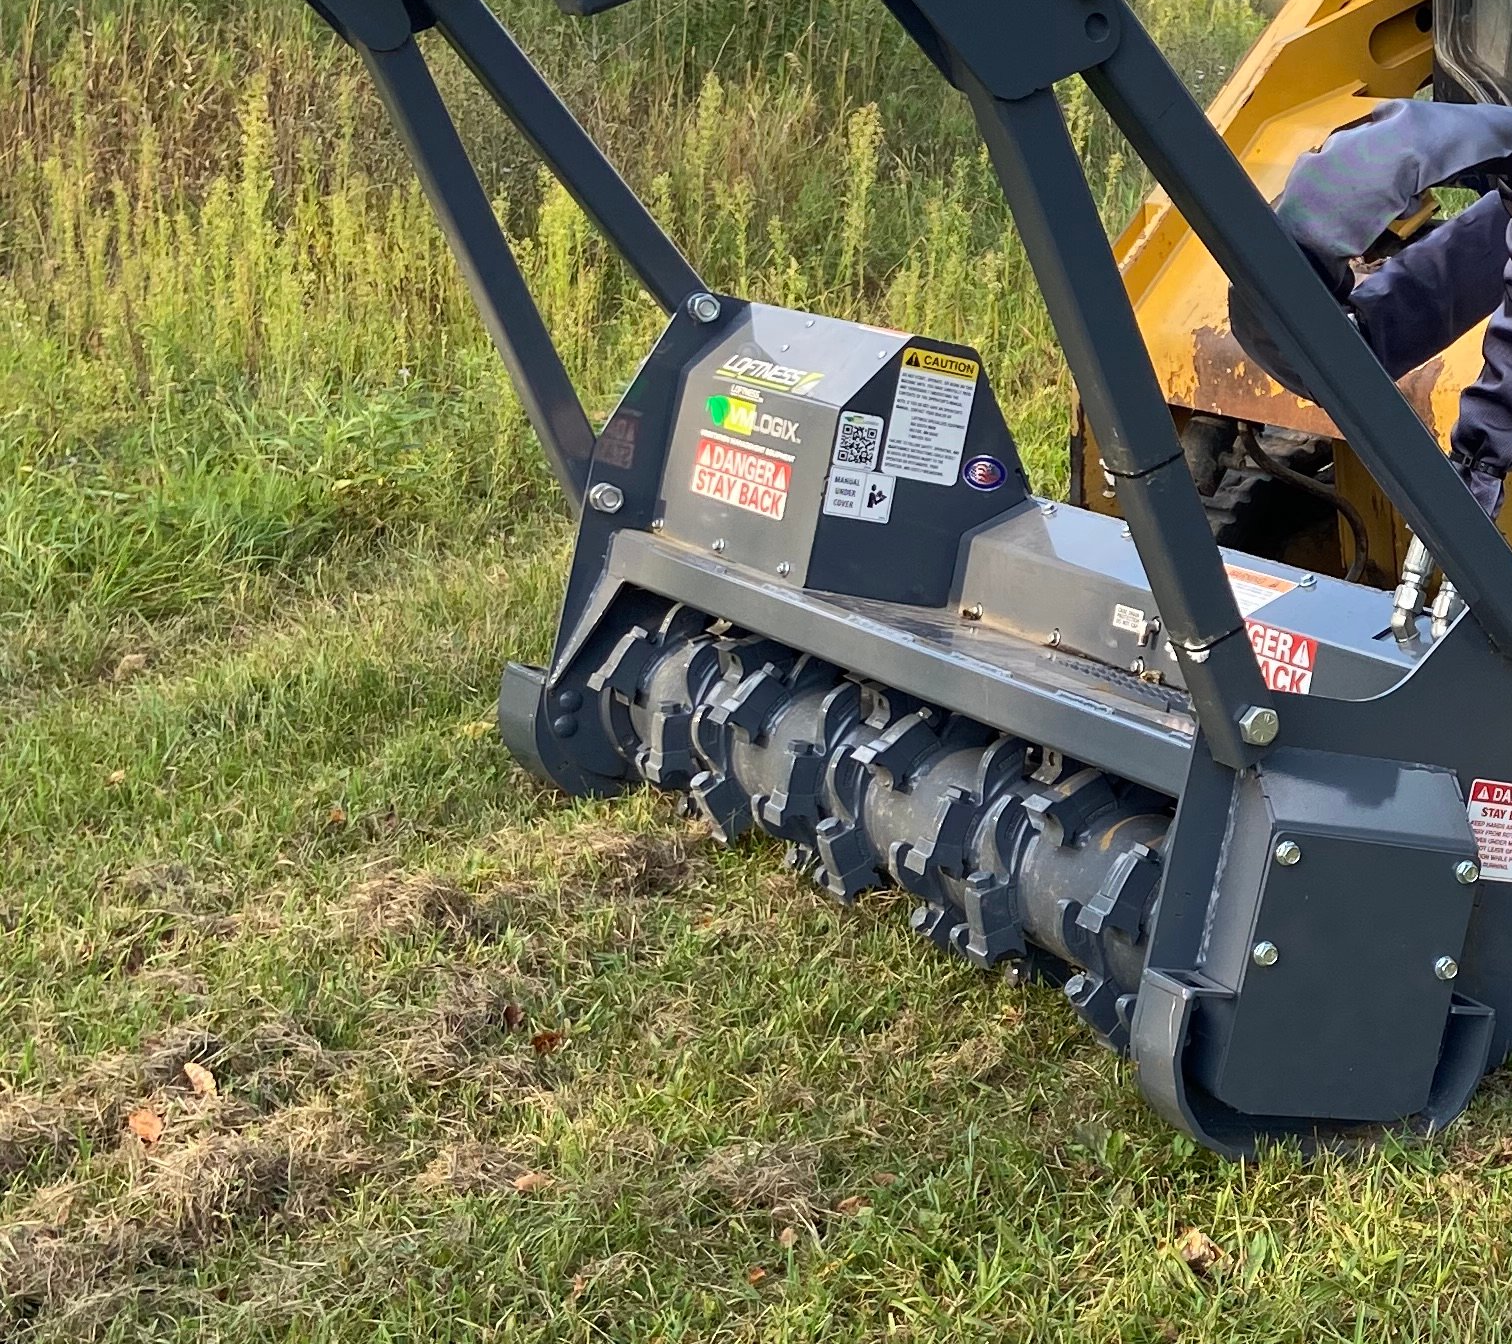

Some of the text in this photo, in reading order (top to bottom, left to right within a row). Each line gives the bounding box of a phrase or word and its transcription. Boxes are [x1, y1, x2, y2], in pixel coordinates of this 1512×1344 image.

[722, 354, 807, 385] LOFTNESS
[923, 355, 975, 375] CAUTION
[711, 445, 777, 487] DANGER
[696, 467, 783, 516] STAY BACK
[834, 476, 861, 487] MANUAL
[834, 487, 857, 498] UNDER
[832, 498, 854, 509] COVER
[1247, 622, 1294, 664] GER
[1261, 661, 1307, 692] ACK
[1480, 807, 1507, 820] STAY
